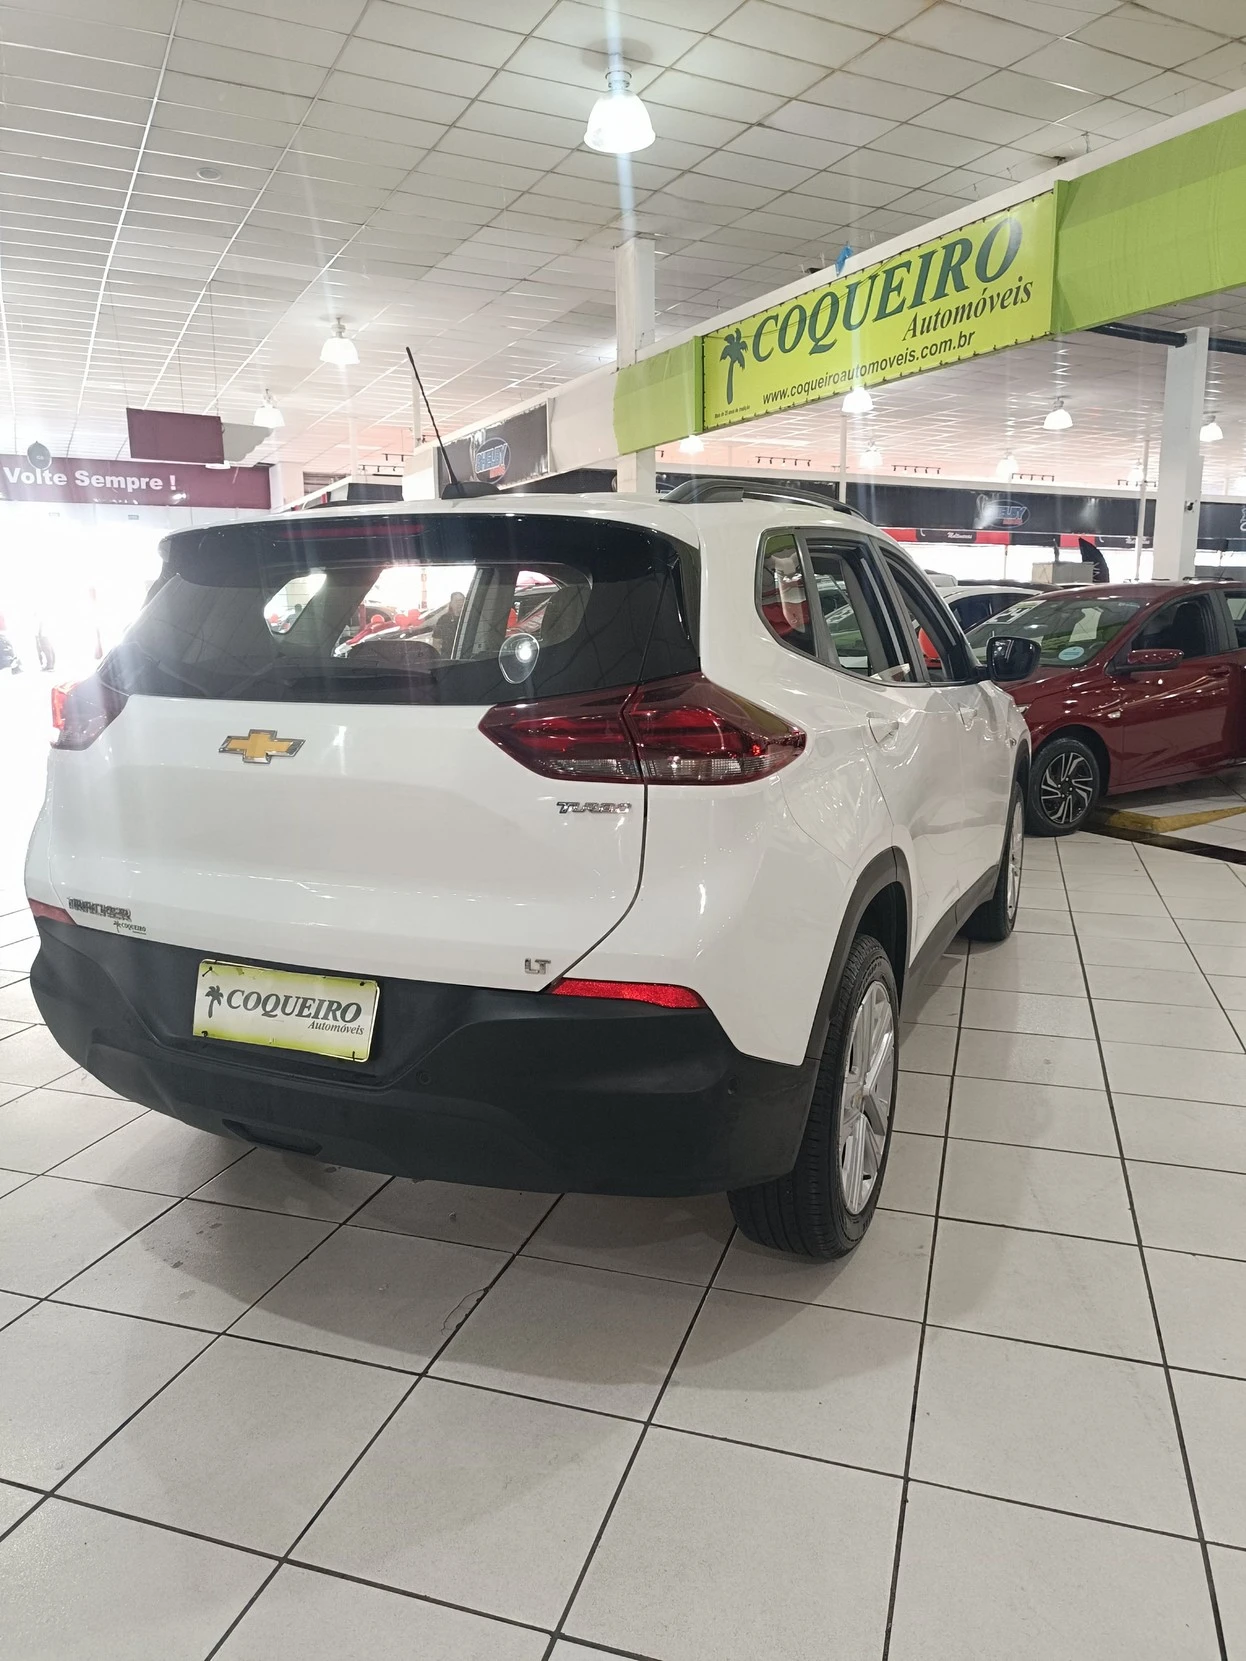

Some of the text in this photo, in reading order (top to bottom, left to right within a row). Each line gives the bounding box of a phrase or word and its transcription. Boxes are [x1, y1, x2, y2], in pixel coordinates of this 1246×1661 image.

[752, 217, 1023, 363] COQUEIRO
[902, 275, 1034, 342] Automóveis
[762, 330, 976, 405] www.coqueiroautomoveis.com.br
[3, 466, 67, 485] Volte
[75, 470, 163, 492] Sempre
[525, 958, 551, 975] LT
[226, 989, 362, 1024] COQUEIRO
[307, 1020, 365, 1036] Automóveis
